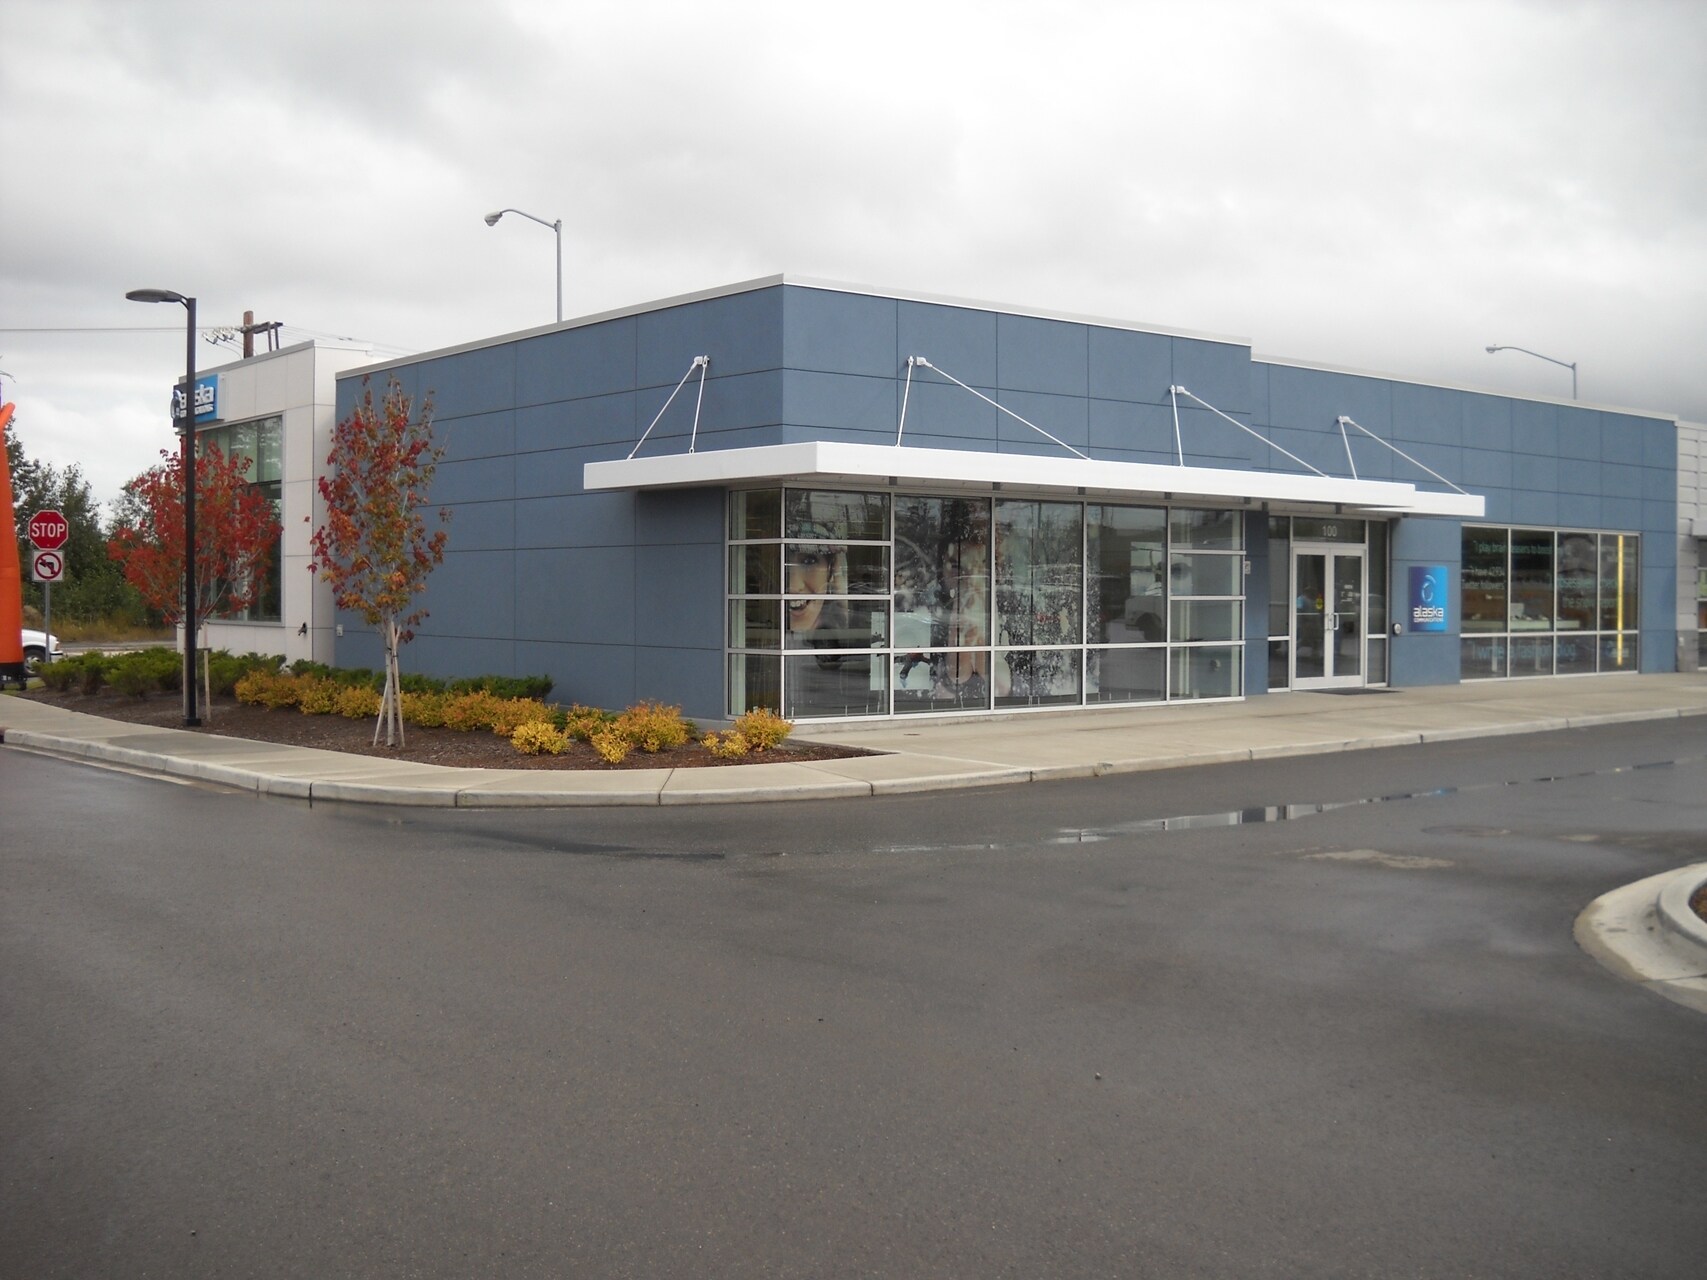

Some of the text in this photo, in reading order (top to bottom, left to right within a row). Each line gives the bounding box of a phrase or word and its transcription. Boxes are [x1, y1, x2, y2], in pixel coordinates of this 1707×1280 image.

[31, 522, 65, 538] STOP
[1322, 525, 1338, 537] 100
[1413, 605, 1444, 617] alaska
